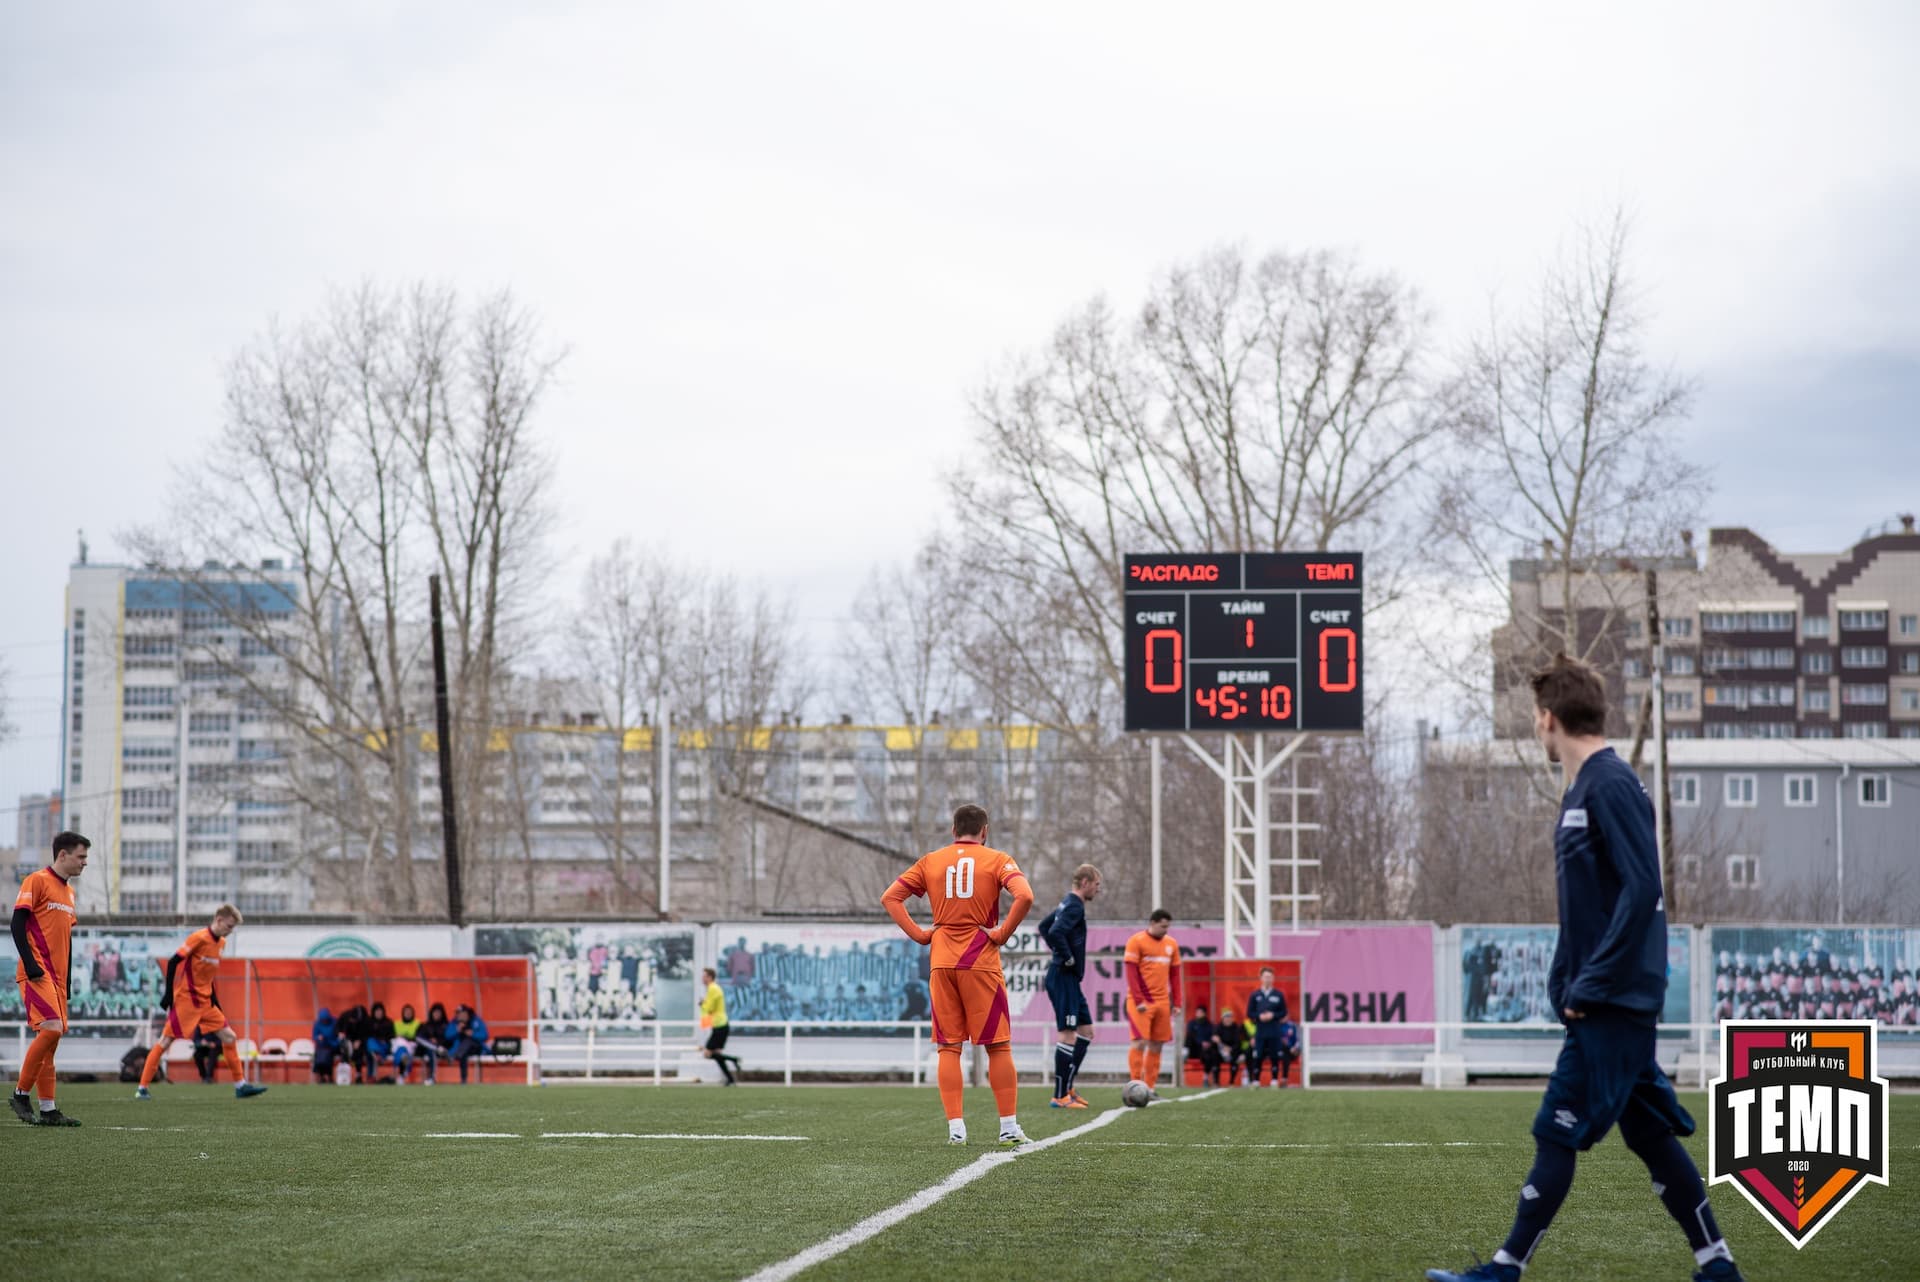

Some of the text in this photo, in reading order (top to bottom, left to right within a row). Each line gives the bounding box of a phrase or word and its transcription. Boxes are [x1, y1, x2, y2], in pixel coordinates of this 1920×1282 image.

[1305, 563, 1354, 580] ТЕМП
[1221, 600, 1265, 615] ТАЙМ
[1136, 611, 1177, 625] СЧЕТ
[1310, 610, 1351, 624] СЧЕТ
[1245, 618, 1255, 648] 1
[1145, 629, 1182, 693] 0
[1318, 628, 1357, 692] 0
[1217, 671, 1270, 684] ВРЕМЯ
[945, 857, 975, 899] 10
[1005, 933, 1041, 952] ОРТ
[1005, 975, 1046, 992] ИЗН
[1304, 992, 1406, 1022] ИЗНИ
